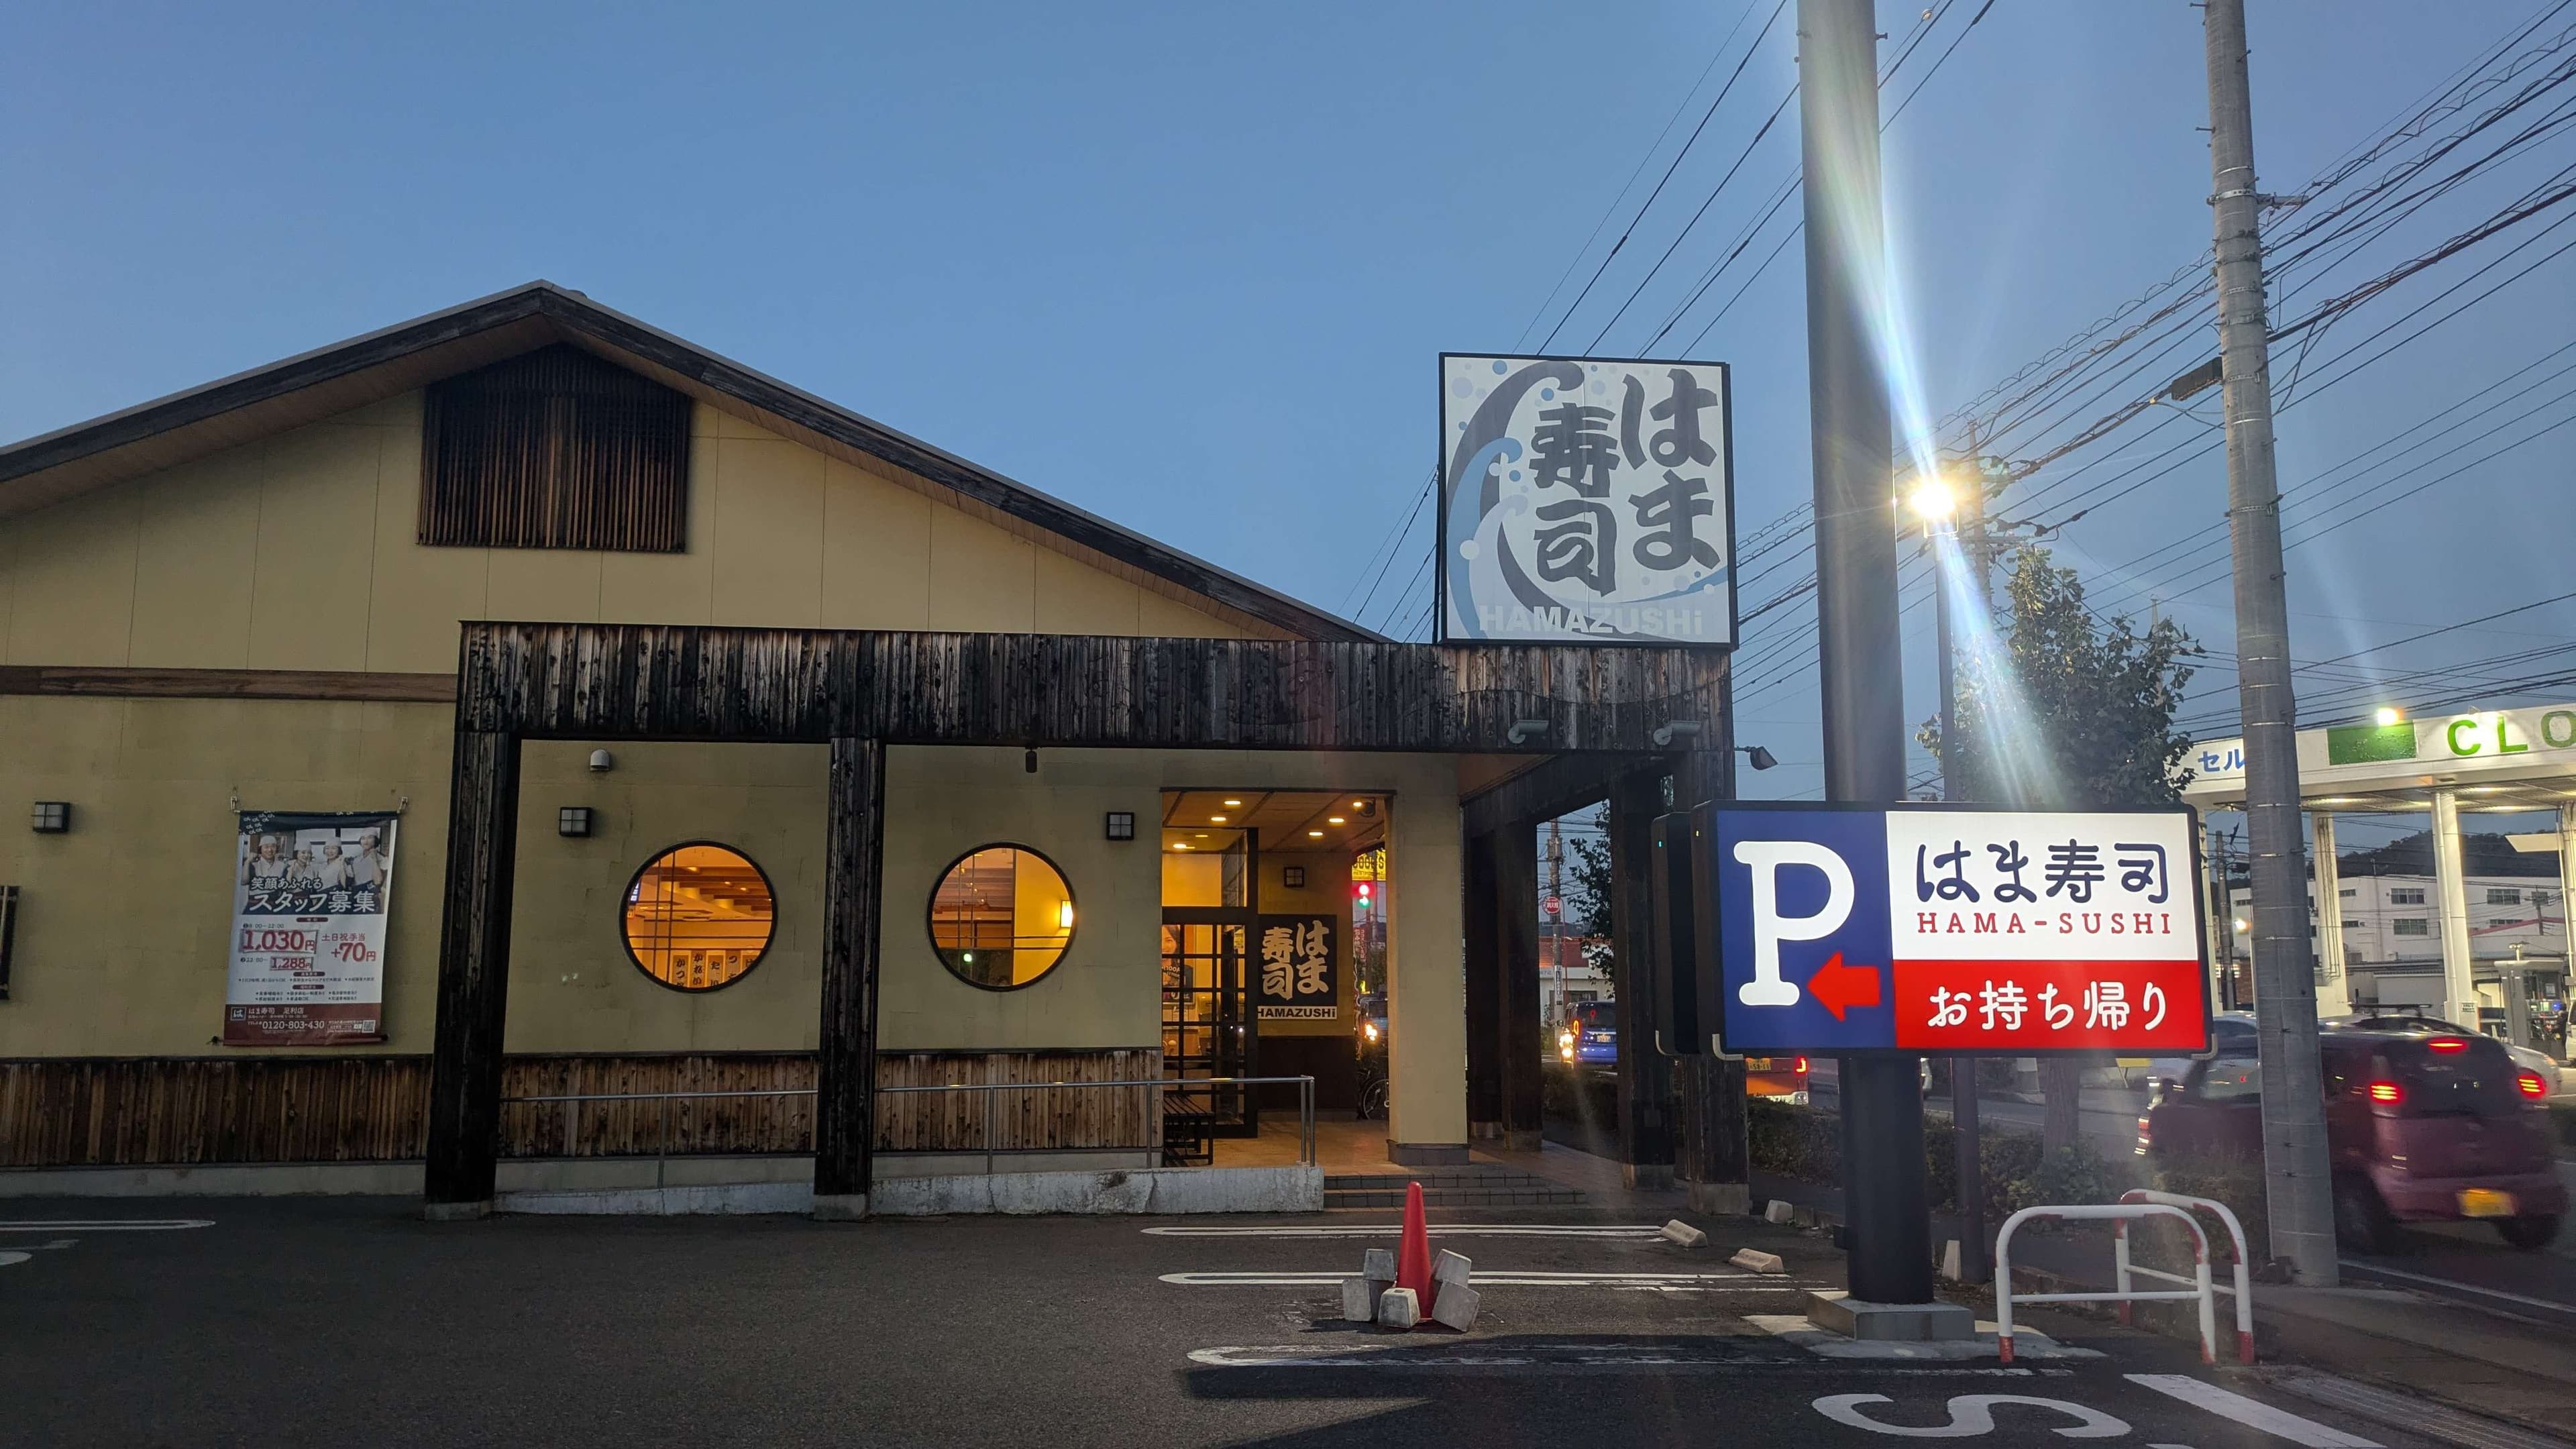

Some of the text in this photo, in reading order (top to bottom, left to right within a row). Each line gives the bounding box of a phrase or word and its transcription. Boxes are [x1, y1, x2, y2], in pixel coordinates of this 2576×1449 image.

[1620, 368, 1721, 570] はま
[1529, 402, 1620, 597] 寿司
[1917, 839, 2168, 904] はま寿司
[252, 876, 323, 890] 笑顔あふれる
[249, 890, 376, 913] スタッフ募集
[1733, 840, 1855, 1006] P
[1917, 912, 2171, 934] HAMA-SUSHI
[243, 929, 316, 951] 1,030円
[321, 933, 366, 942] 土日祝手当
[271, 957, 311, 969] 1,288円
[331, 942, 376, 962] +70円
[1261, 926, 1293, 1000] 寿司
[1296, 920, 1329, 994] はま
[233, 1009, 244, 1018] は
[1927, 979, 2167, 1030] お持ち帰り
[262, 1020, 325, 1030] 0120-803-430
